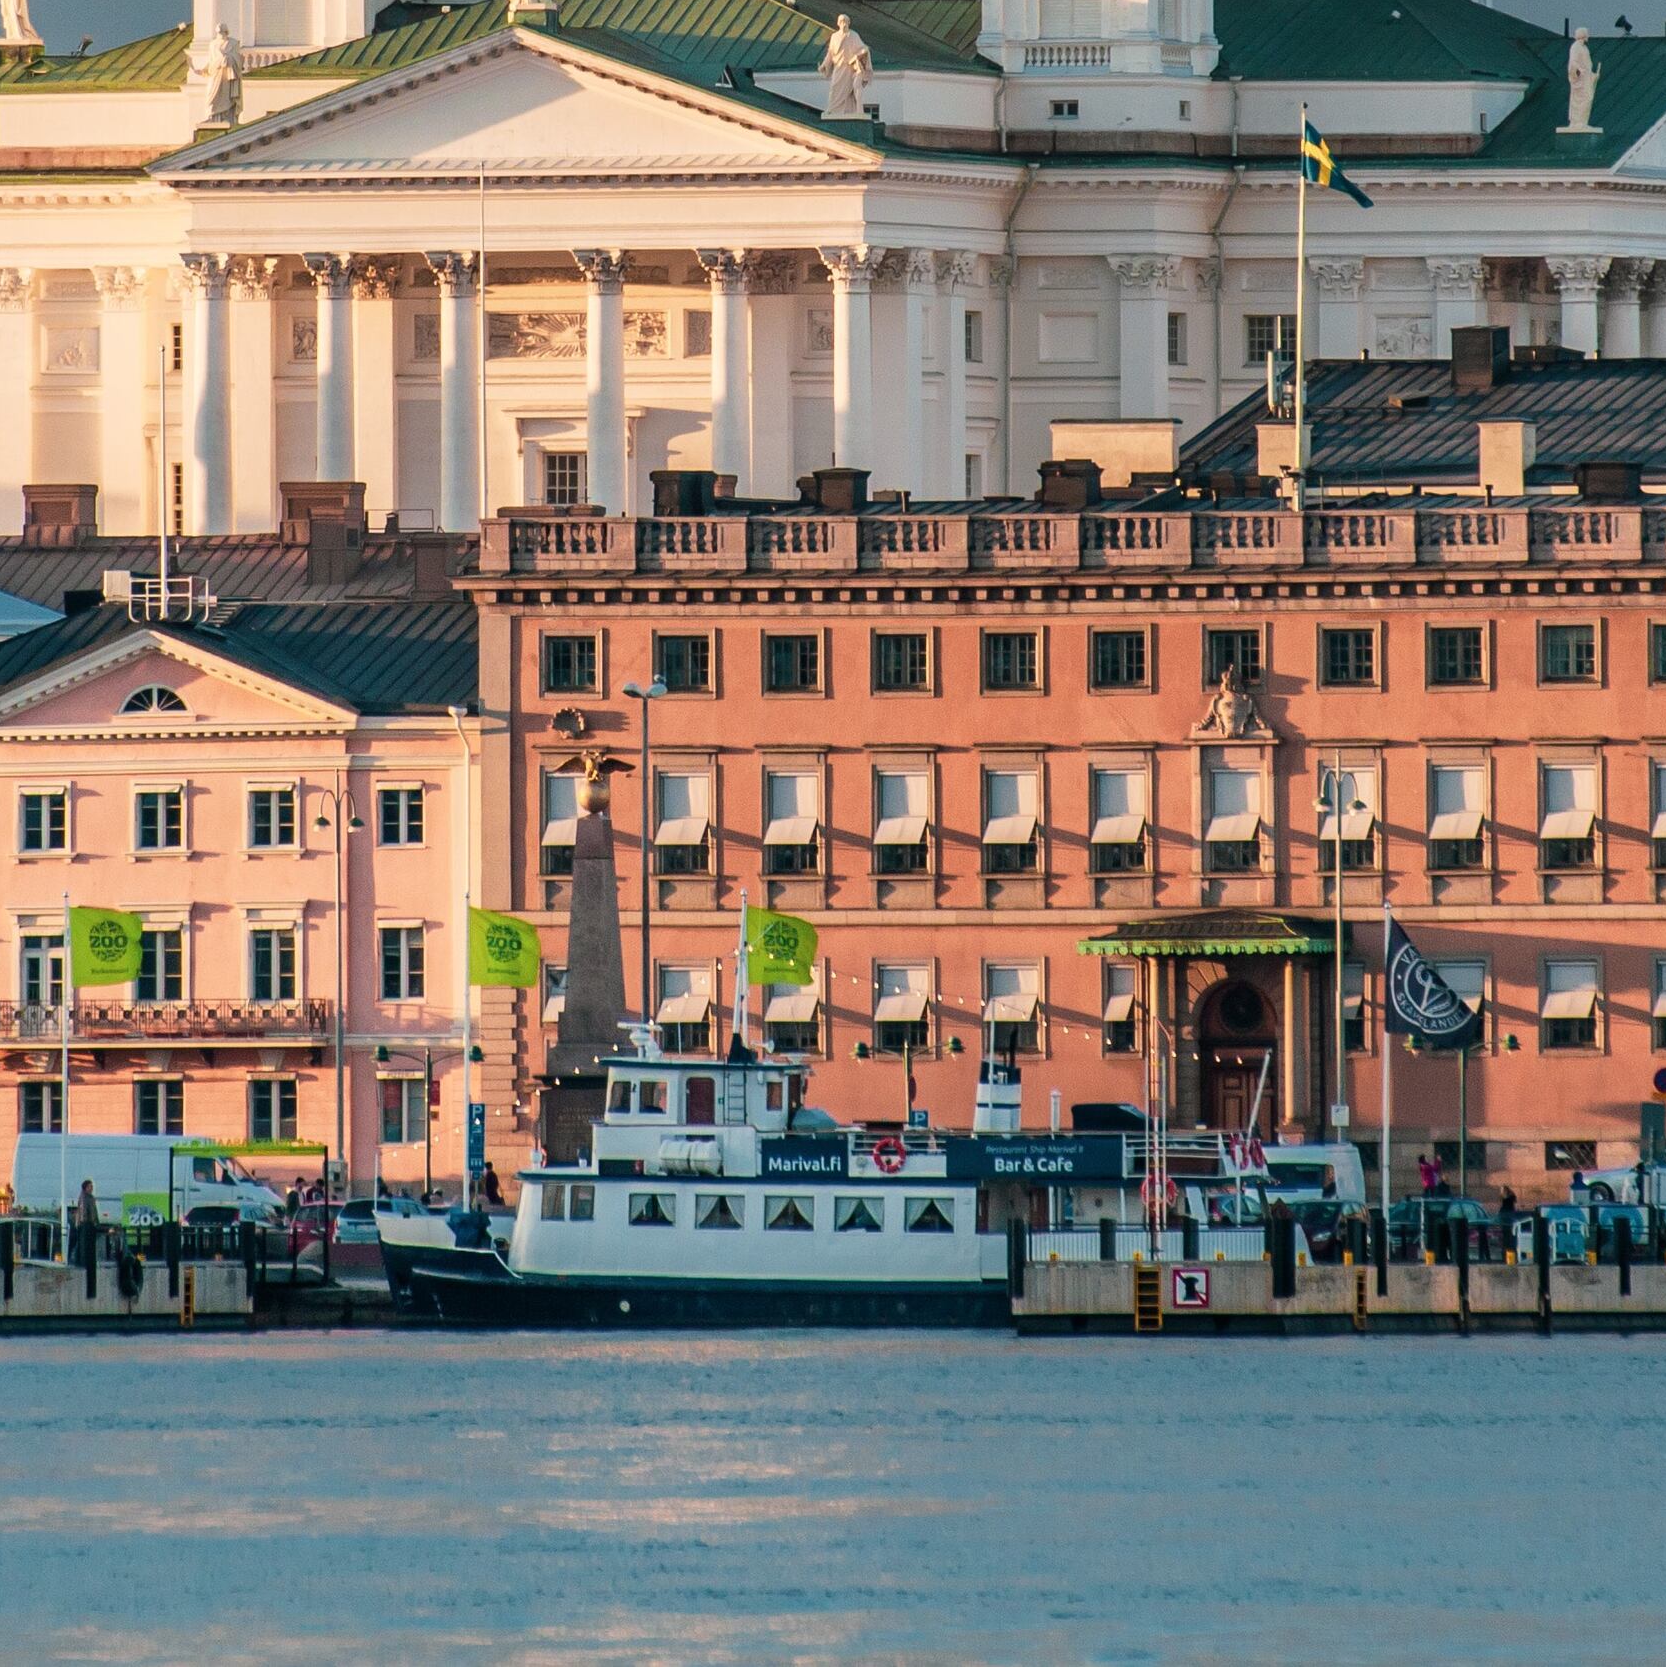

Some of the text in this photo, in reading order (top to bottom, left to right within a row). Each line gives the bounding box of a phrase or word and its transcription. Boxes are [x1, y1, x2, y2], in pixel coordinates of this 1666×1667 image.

[90, 935, 129, 950] ZOO
[486, 936, 523, 951] ZOO
[764, 933, 799, 949] ZOO
[472, 1105, 483, 1119] P
[915, 1112, 926, 1123] P
[768, 1155, 841, 1172] Marival.fi
[994, 1156, 1074, 1172] Bar & Cafe
[129, 1213, 164, 1226] ZOO
